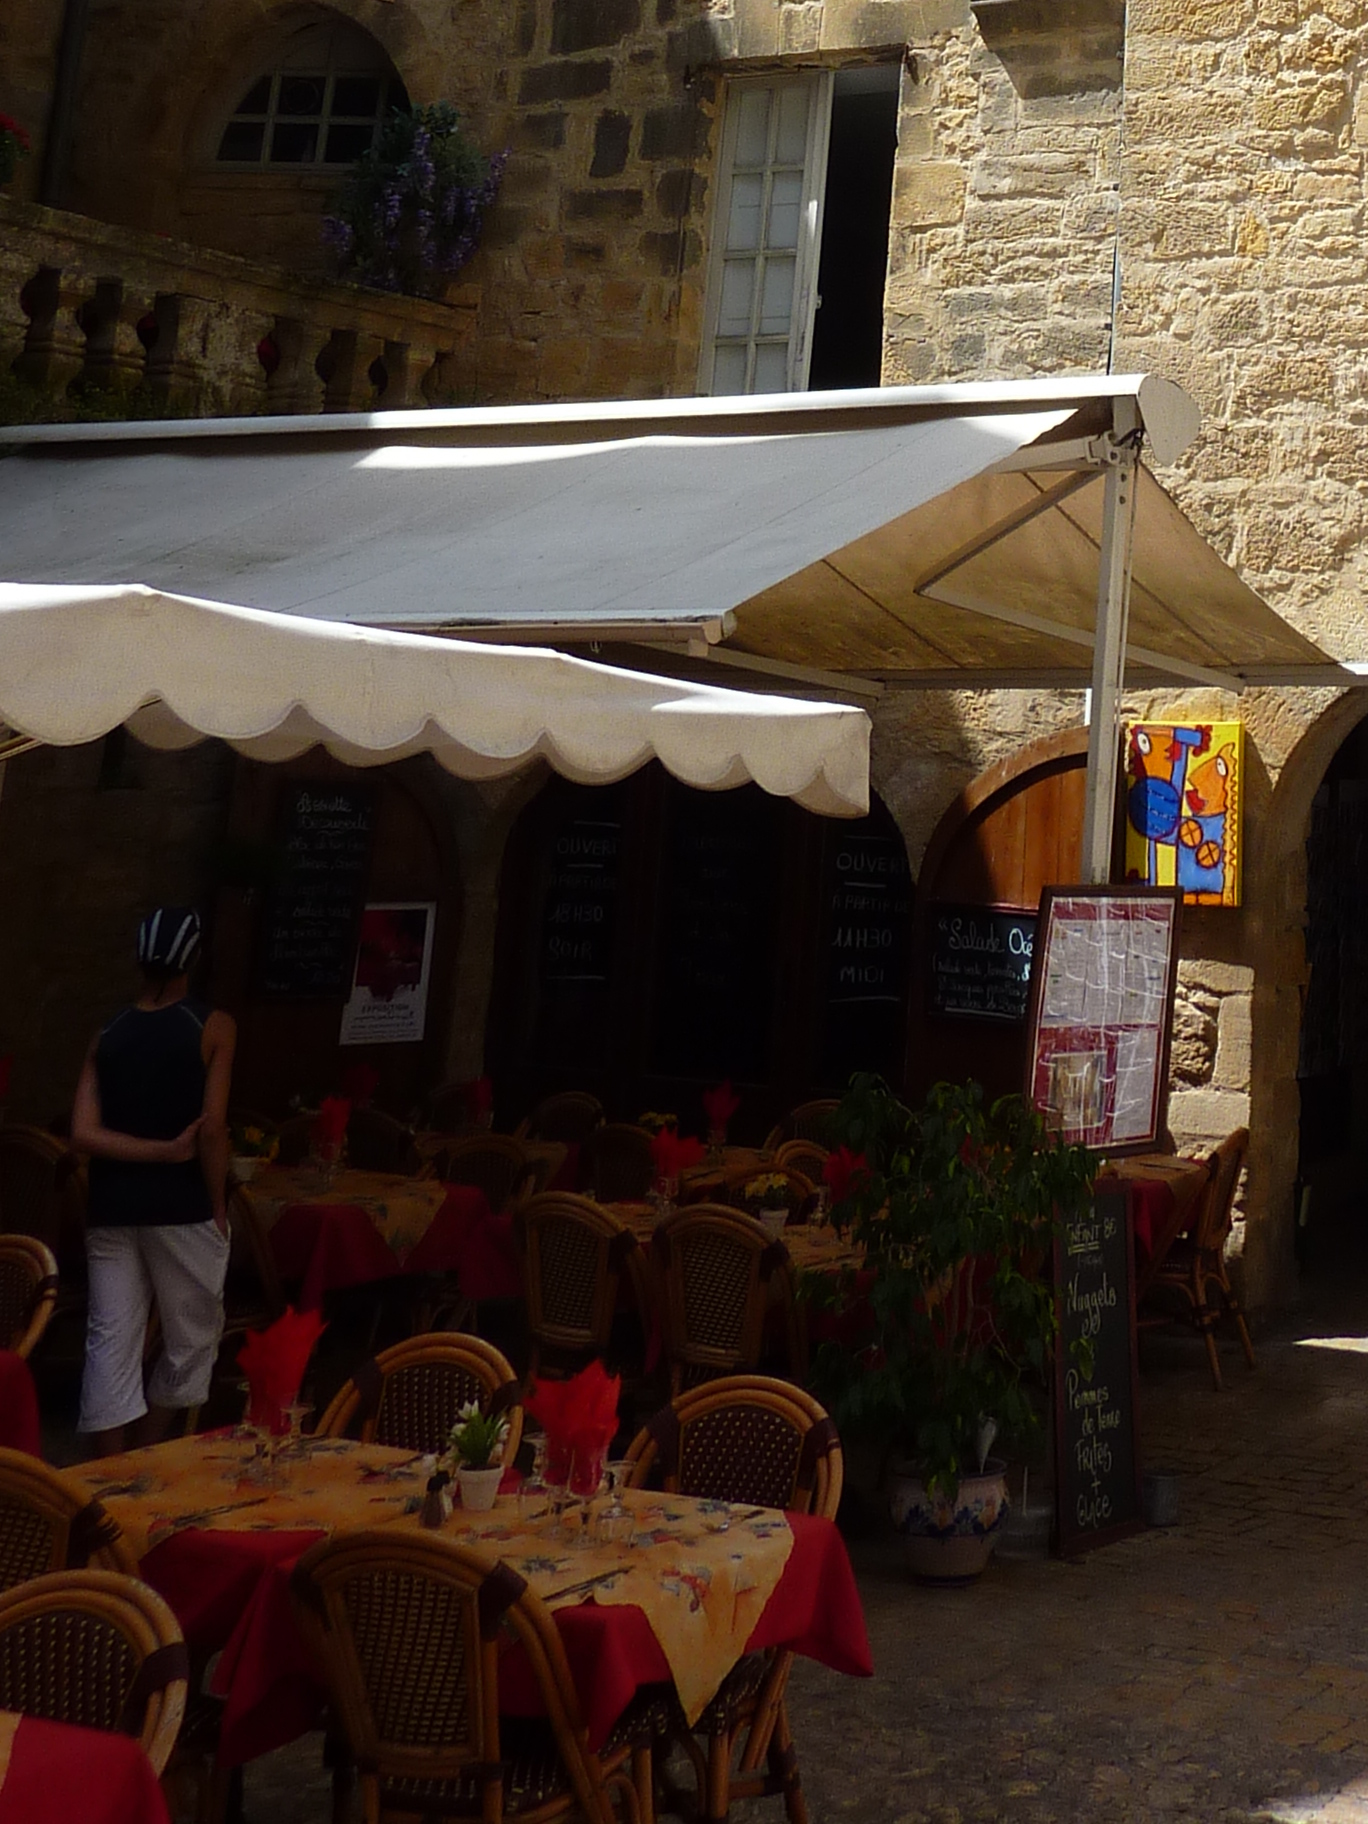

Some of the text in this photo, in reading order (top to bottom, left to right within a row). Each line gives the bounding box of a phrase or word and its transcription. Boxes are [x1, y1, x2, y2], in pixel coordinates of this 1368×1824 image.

[556, 836, 620, 856] OUVERT
[831, 926, 892, 949] 11H30
[839, 965, 884, 984] MIDI
[1066, 1271, 1117, 1339] Nuggets
[1065, 1369, 1110, 1411] Pommes
